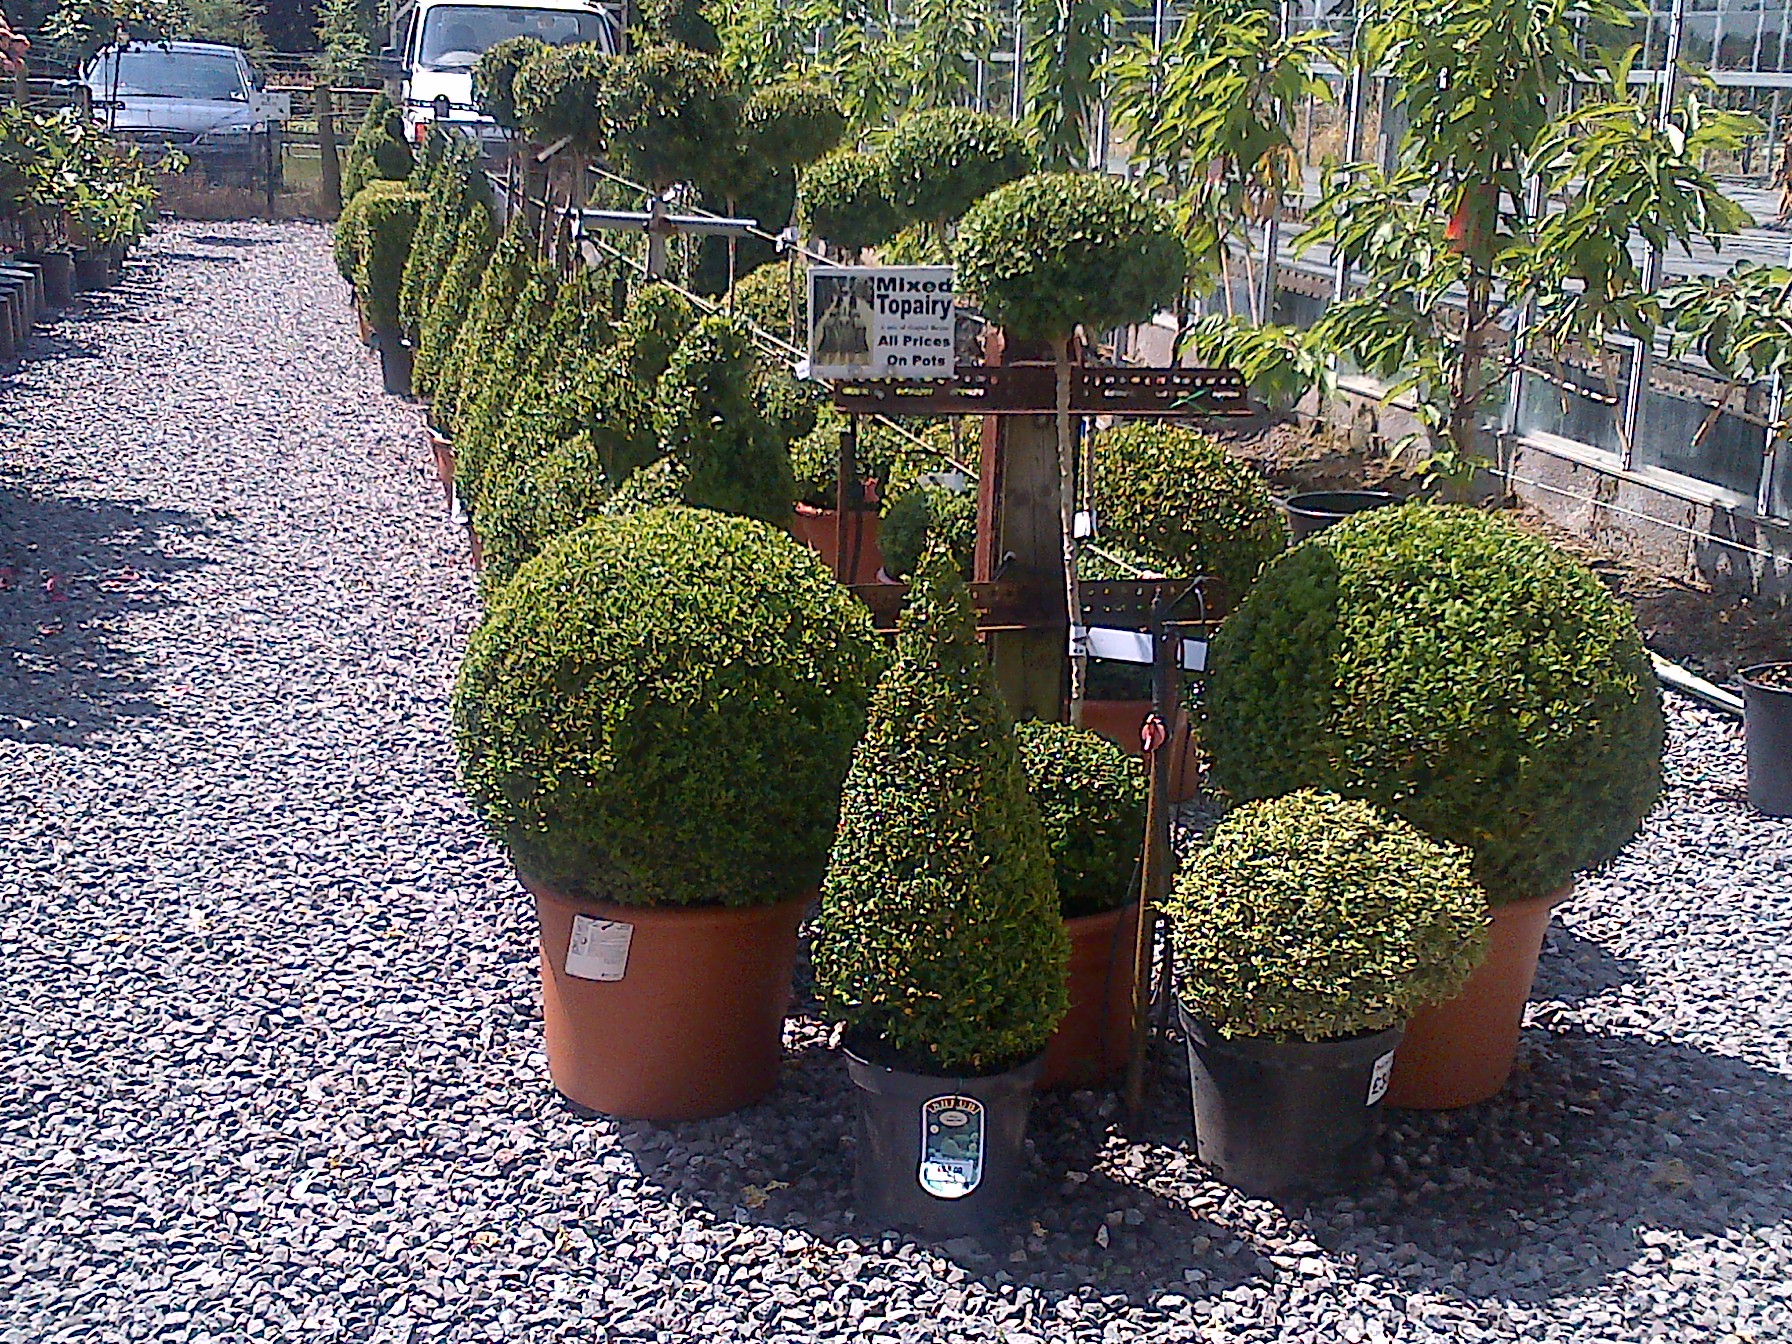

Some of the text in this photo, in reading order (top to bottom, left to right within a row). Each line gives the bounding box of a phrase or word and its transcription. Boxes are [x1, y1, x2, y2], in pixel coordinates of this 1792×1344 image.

[876, 277, 951, 293] Mixed
[876, 294, 952, 320] Topairy
[877, 335, 951, 347] All Prices
[887, 355, 946, 367] On Pots
